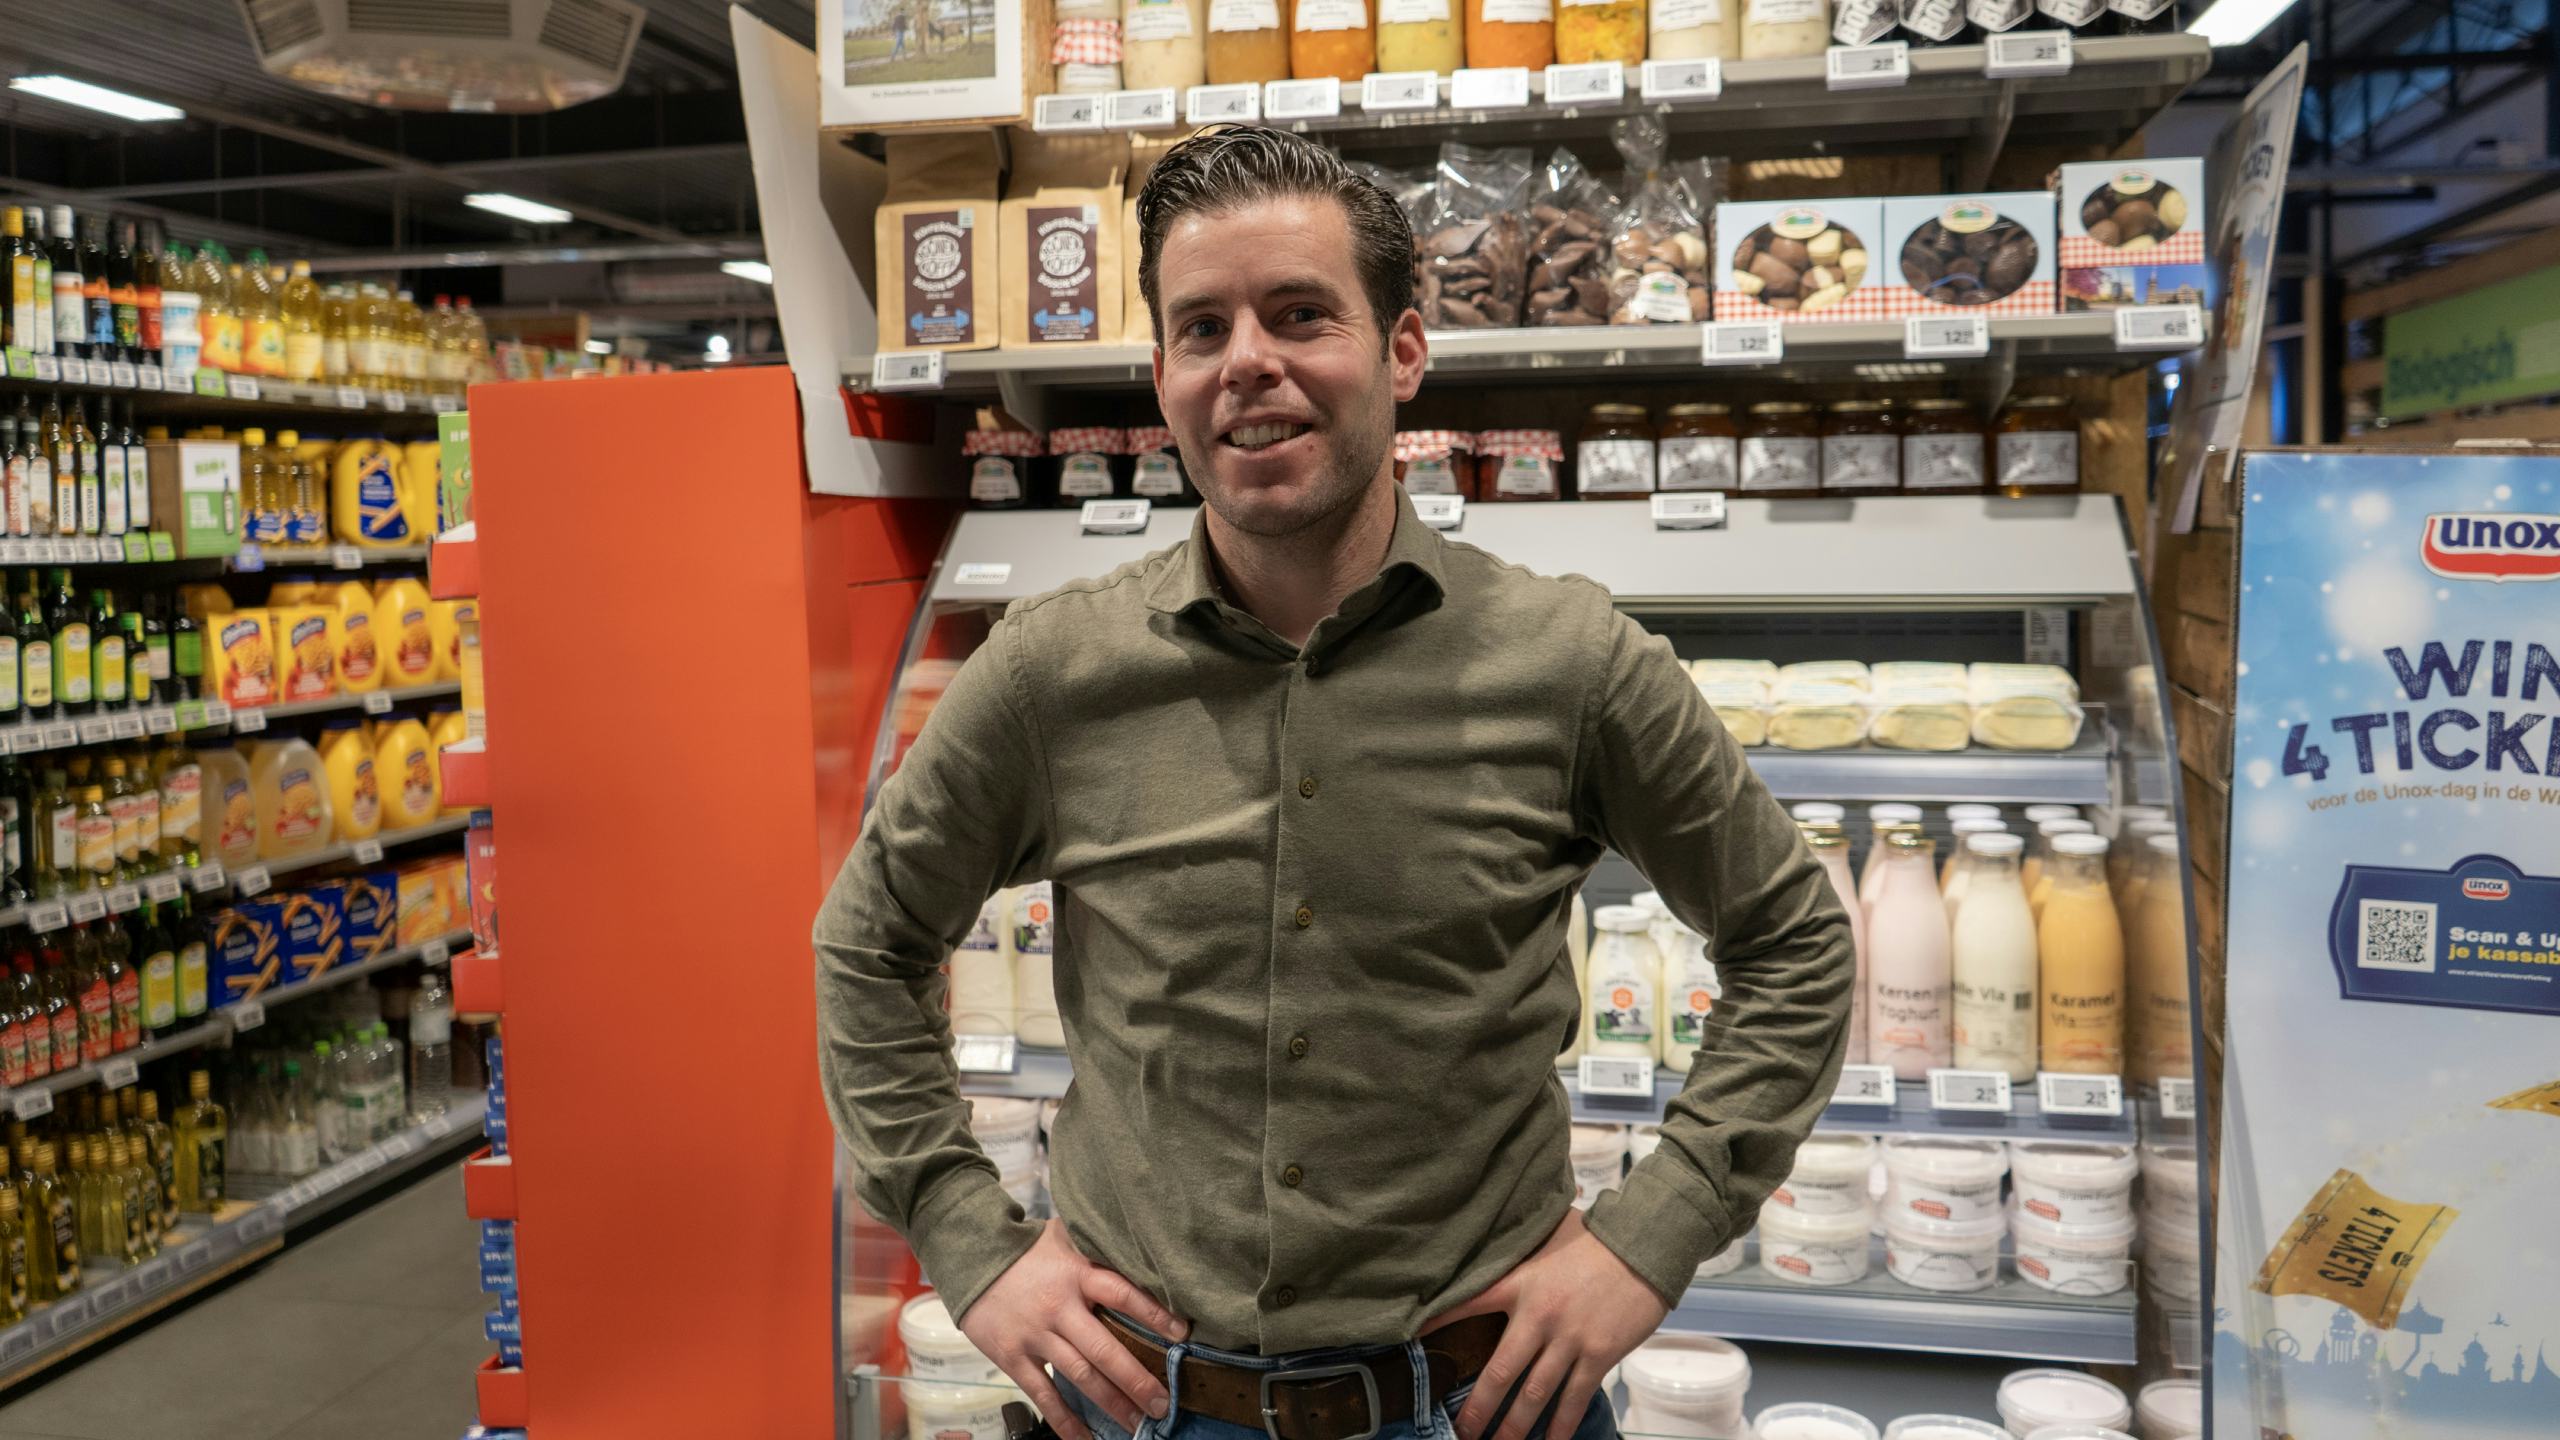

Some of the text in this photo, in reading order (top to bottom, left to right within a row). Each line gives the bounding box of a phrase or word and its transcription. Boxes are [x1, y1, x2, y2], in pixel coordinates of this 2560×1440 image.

[2389, 325, 2515, 402] Biologisch
[2282, 723, 2330, 781] 4
[2307, 792, 2348, 811] voor
[2354, 787, 2378, 803] de
[2383, 782, 2477, 801] Unox-dag
[2483, 782, 2501, 799] in
[2507, 785, 2531, 801] de
[2449, 926, 2508, 945] Scan
[2515, 931, 2533, 946] &
[2447, 943, 2470, 961] je
[1878, 984, 1932, 1000] Kersen
[1980, 986, 2005, 1002] Vla
[2051, 991, 2116, 1009] Karamel
[1879, 1003, 1940, 1022] Yoghurt
[2317, 1217, 2395, 1287] TICKETS
